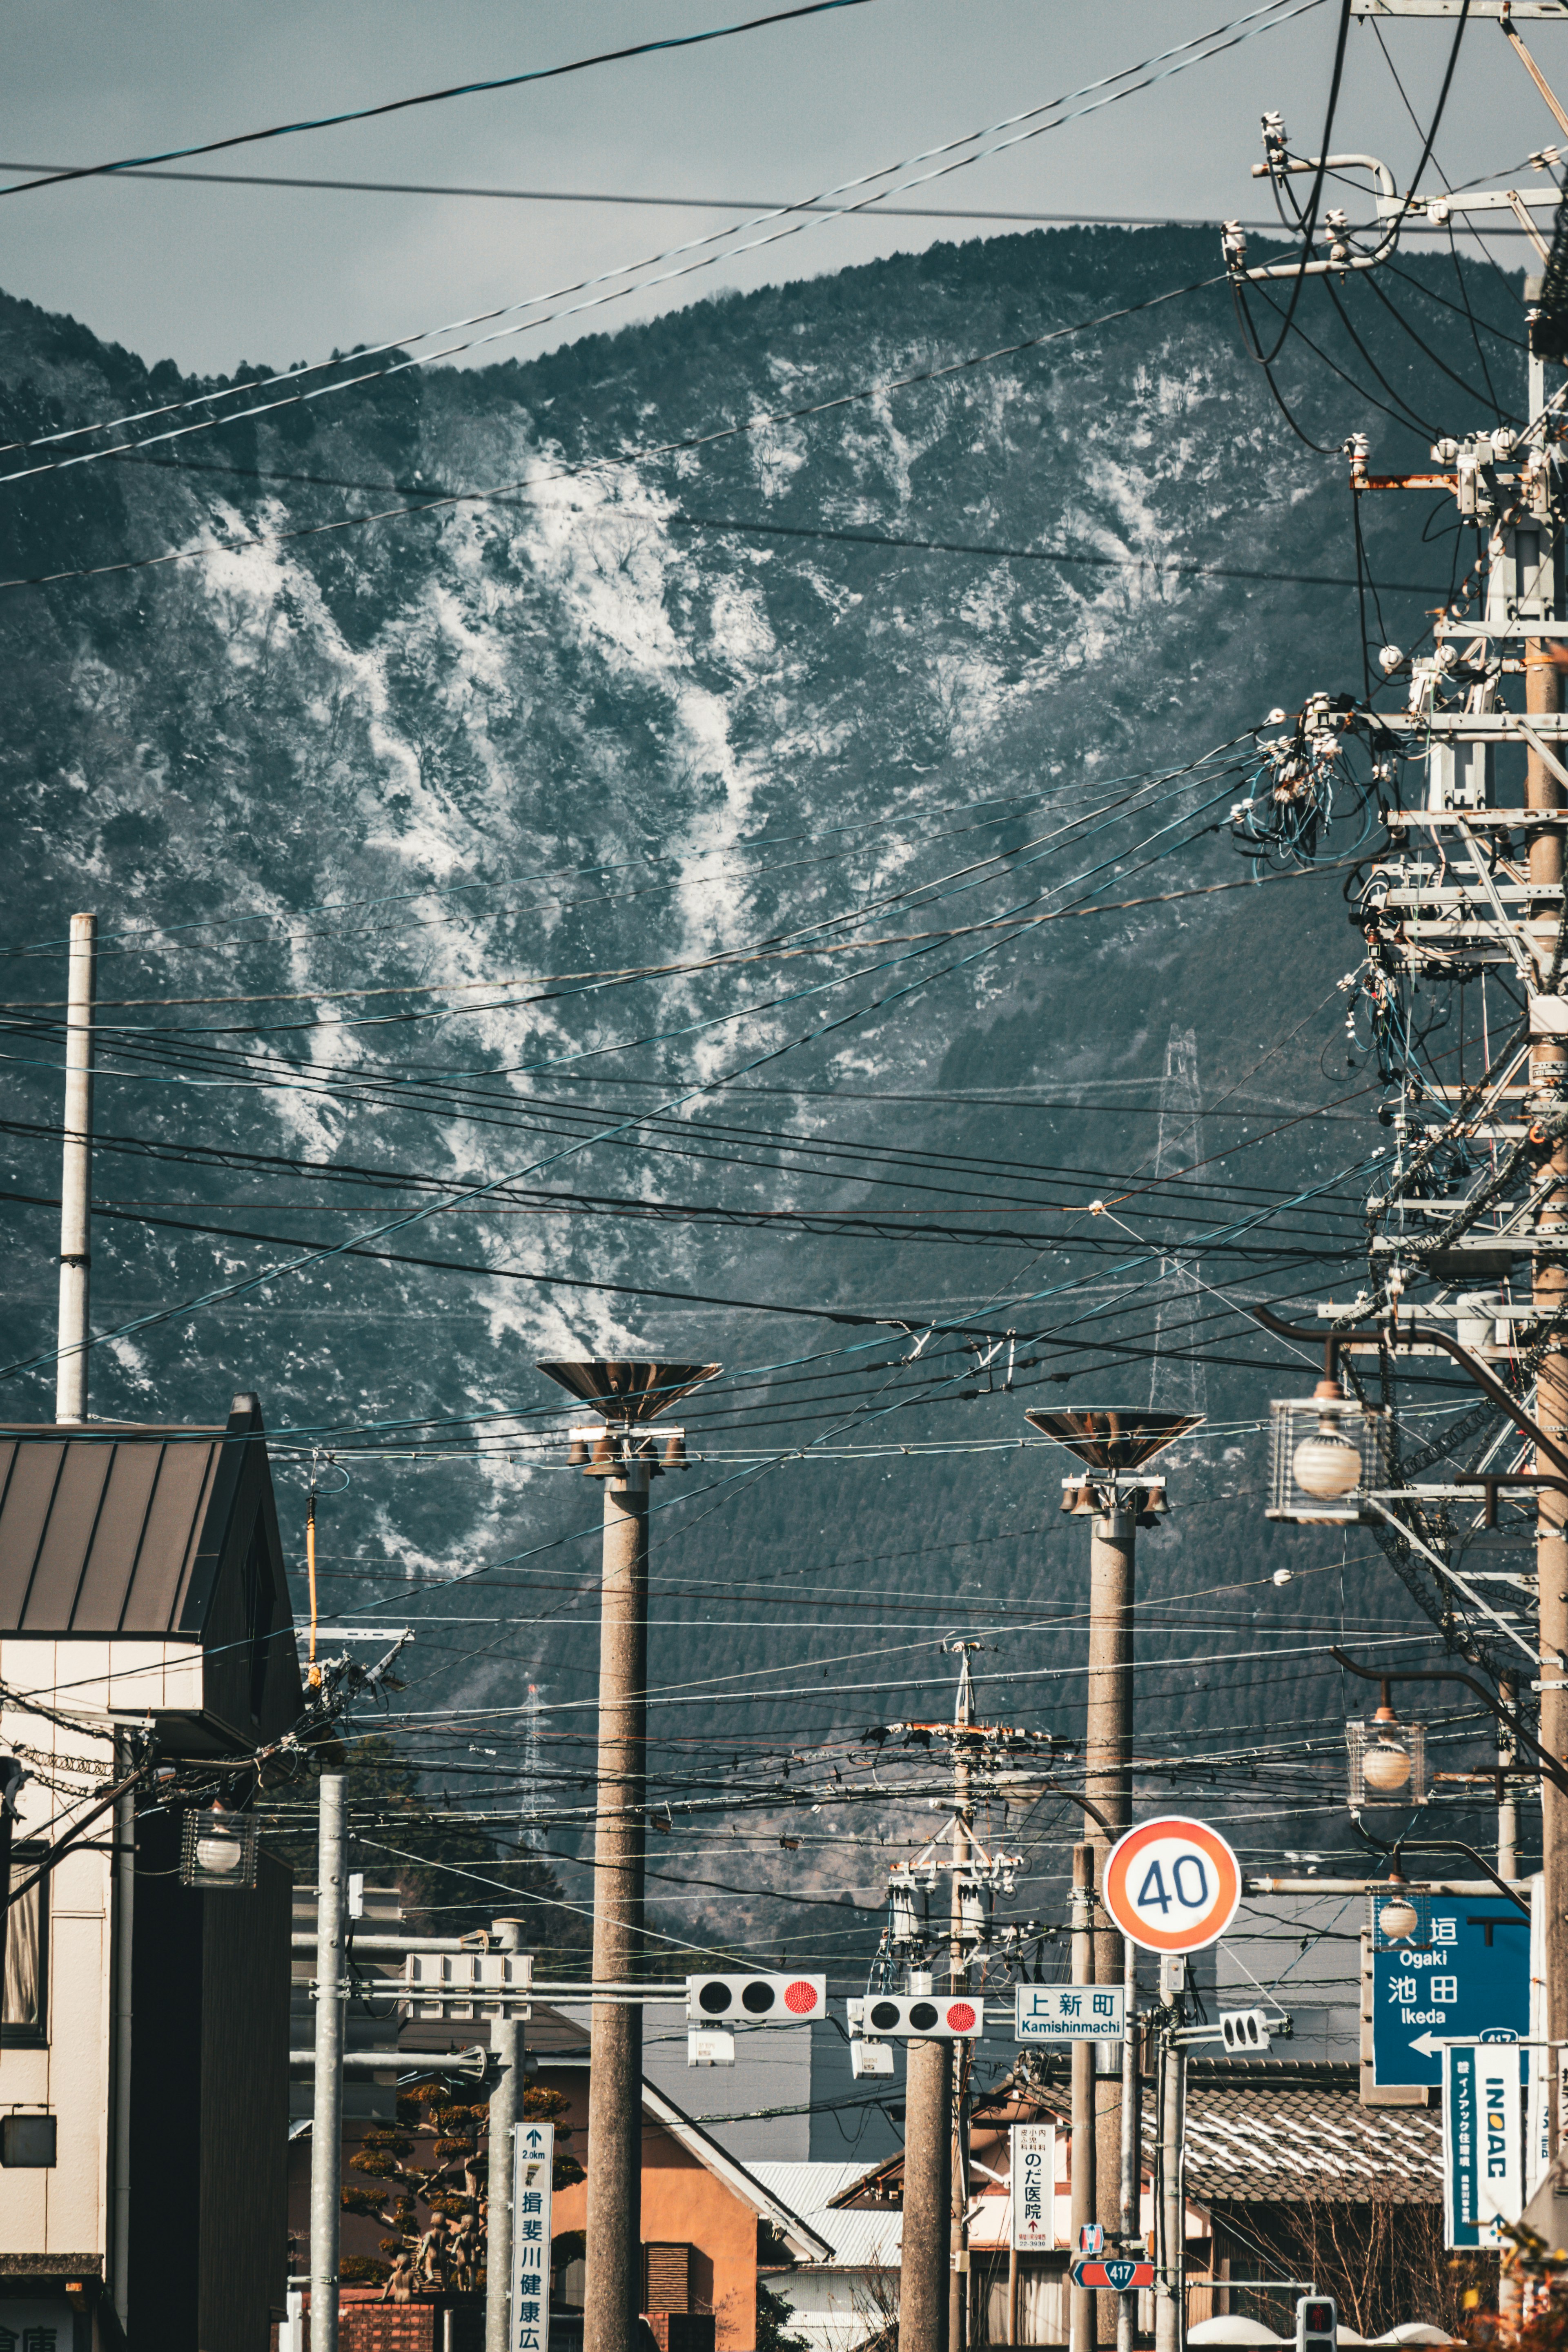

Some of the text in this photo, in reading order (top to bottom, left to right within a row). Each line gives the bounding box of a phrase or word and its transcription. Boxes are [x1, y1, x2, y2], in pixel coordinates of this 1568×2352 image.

[1138, 1855, 1209, 1914] 40
[1400, 1950, 1447, 1969] Ogaki
[1388, 1976, 1457, 2004] 池田
[1027, 1993, 1115, 2017] 上新町
[1401, 2008, 1446, 2024] Ikeda
[1022, 2020, 1120, 2033] Kamishinmachi
[1039, 2129, 1046, 2151] 内科
[522, 2149, 546, 2160] 2.0km
[1025, 2154, 1041, 2220] のだ医院
[519, 2192, 543, 2351] 揖斐川健康広
[1110, 2266, 1131, 2281] 417
